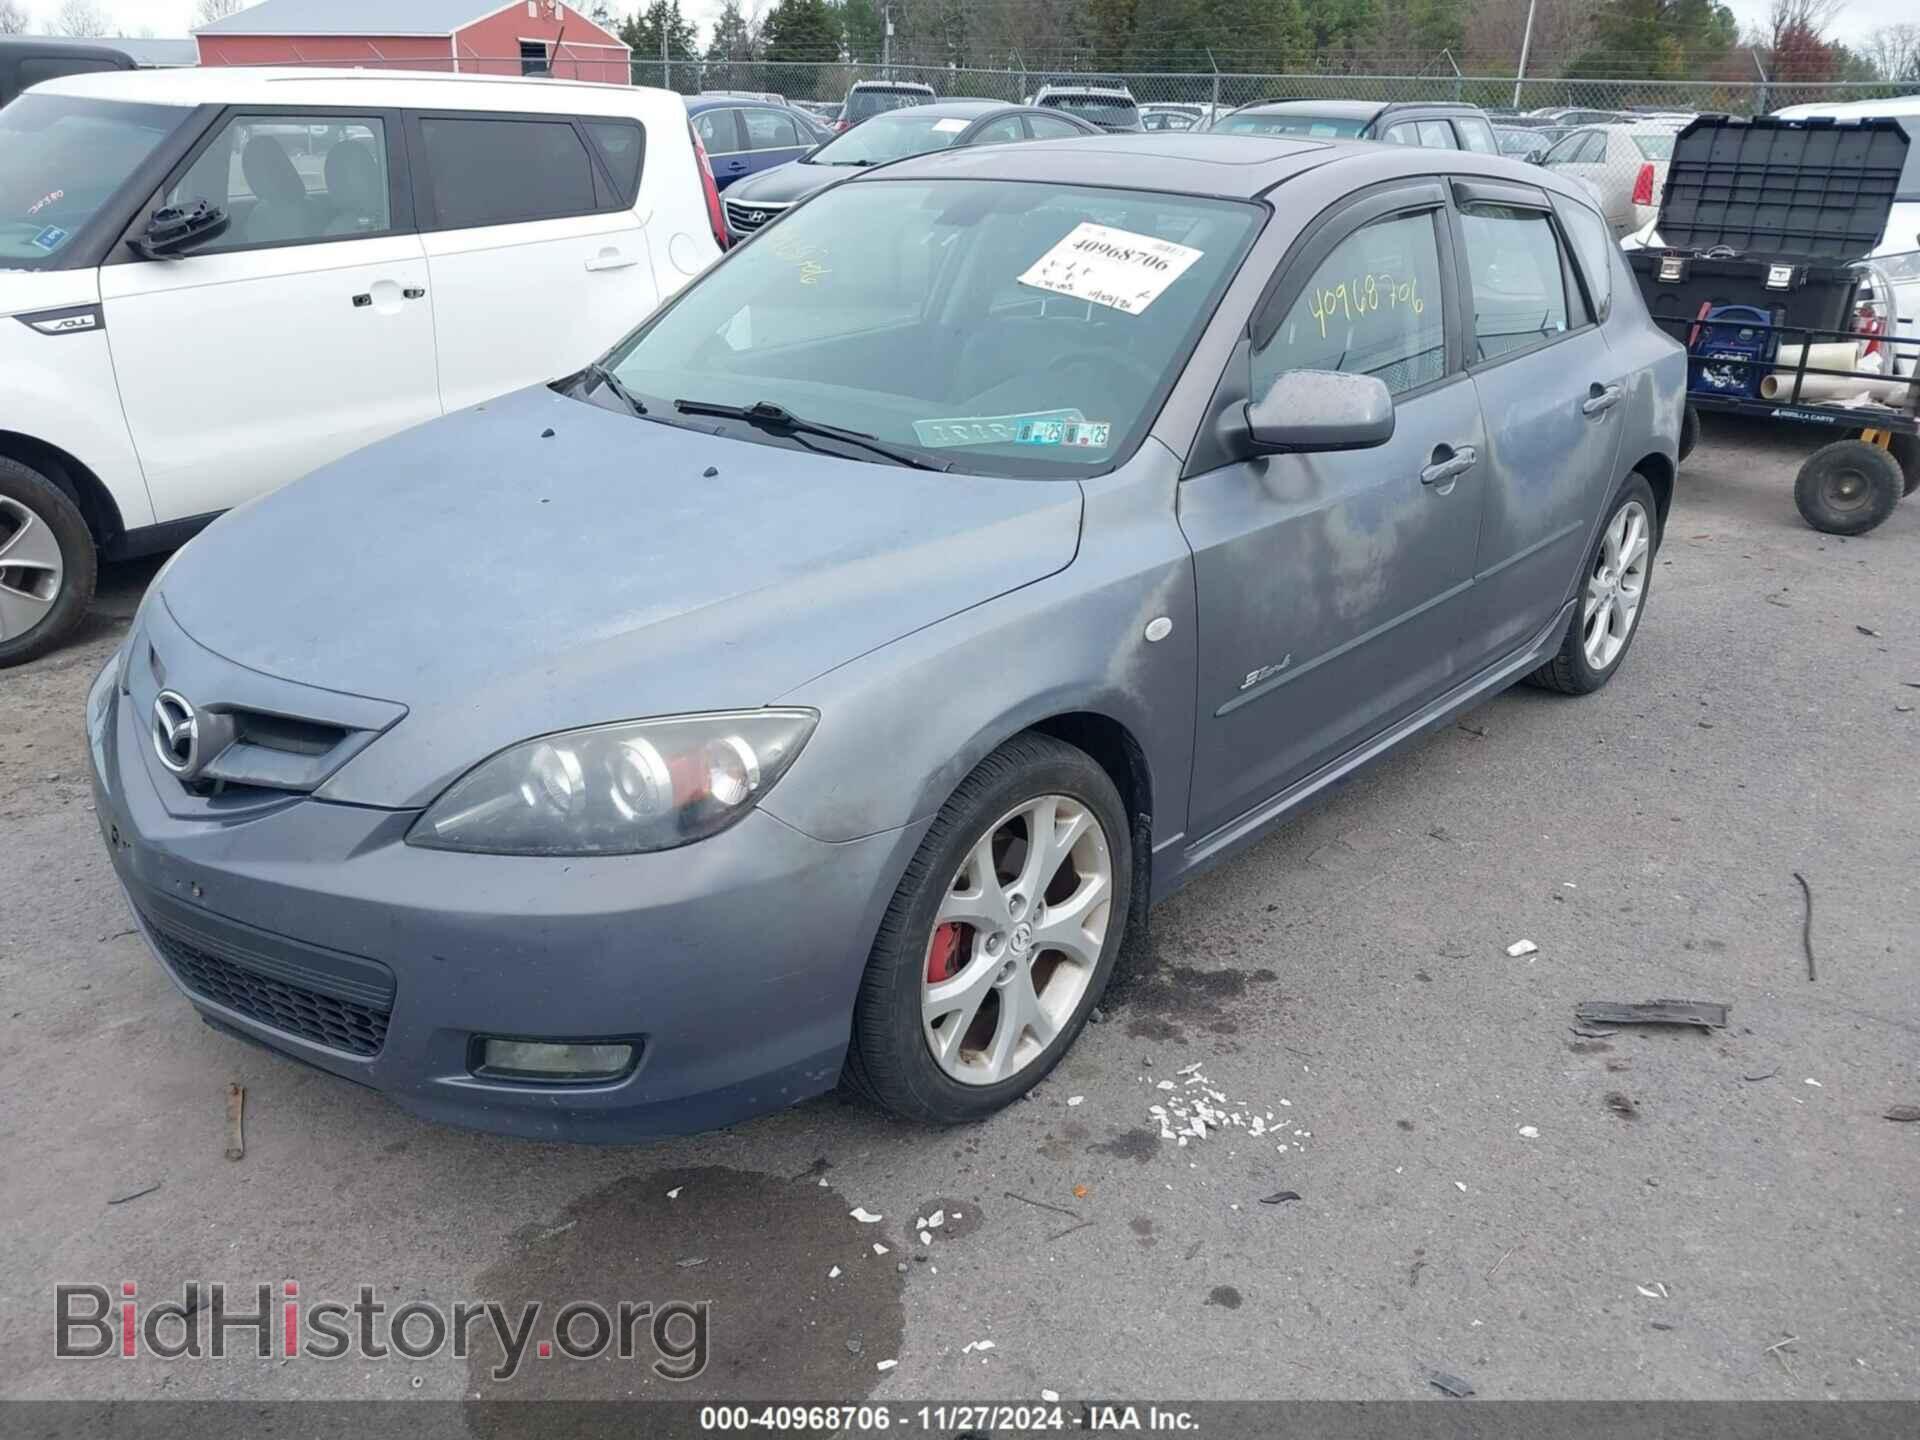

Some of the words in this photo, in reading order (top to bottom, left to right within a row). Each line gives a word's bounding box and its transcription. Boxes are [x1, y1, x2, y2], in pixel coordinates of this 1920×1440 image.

[1073, 239, 1169, 271] 40968706
[1308, 274, 1423, 338] 40968706
[1094, 425, 1108, 444] 25
